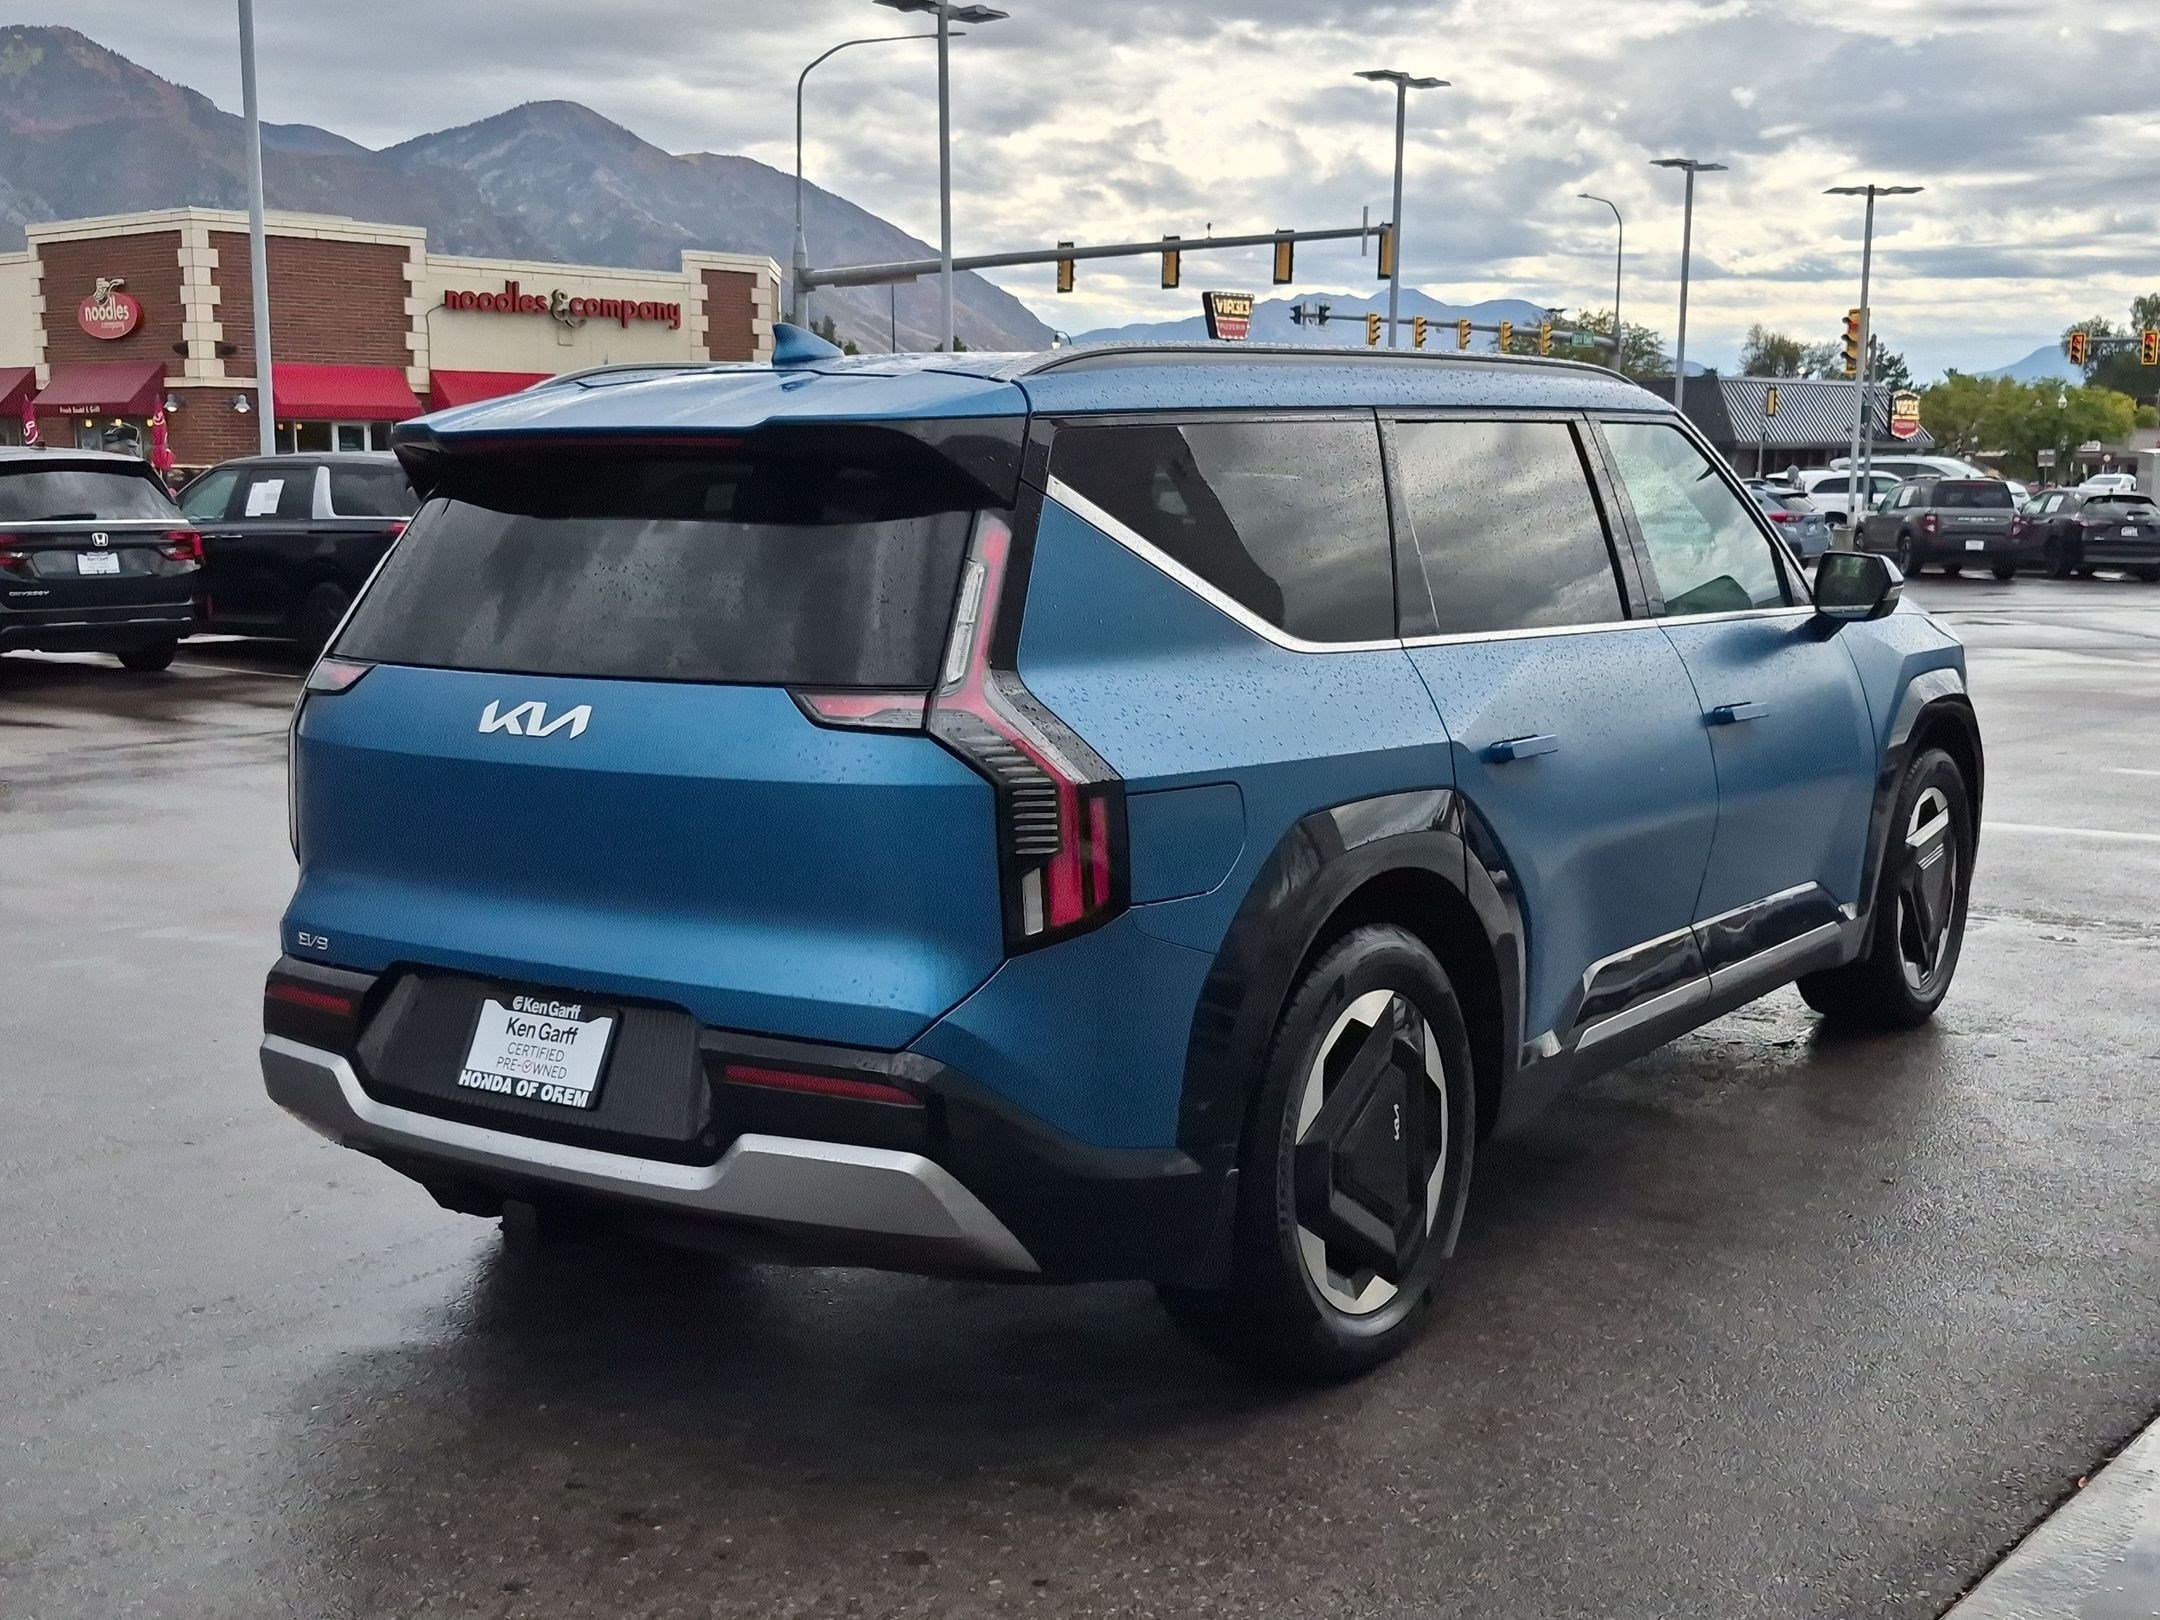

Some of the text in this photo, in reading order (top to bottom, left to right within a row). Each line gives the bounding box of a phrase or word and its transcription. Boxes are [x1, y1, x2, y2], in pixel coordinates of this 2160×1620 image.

[84, 295, 130, 321] noodles
[444, 280, 548, 313] noodles
[569, 297, 681, 330] company
[478, 699, 592, 740] KIA
[298, 931, 329, 950] EV9
[522, 996, 581, 1020] Ken Garff
[505, 1016, 579, 1045] Ken Garff
[507, 1042, 565, 1063] CERTIFIED
[458, 1069, 590, 1109] HONDA OF OREM
